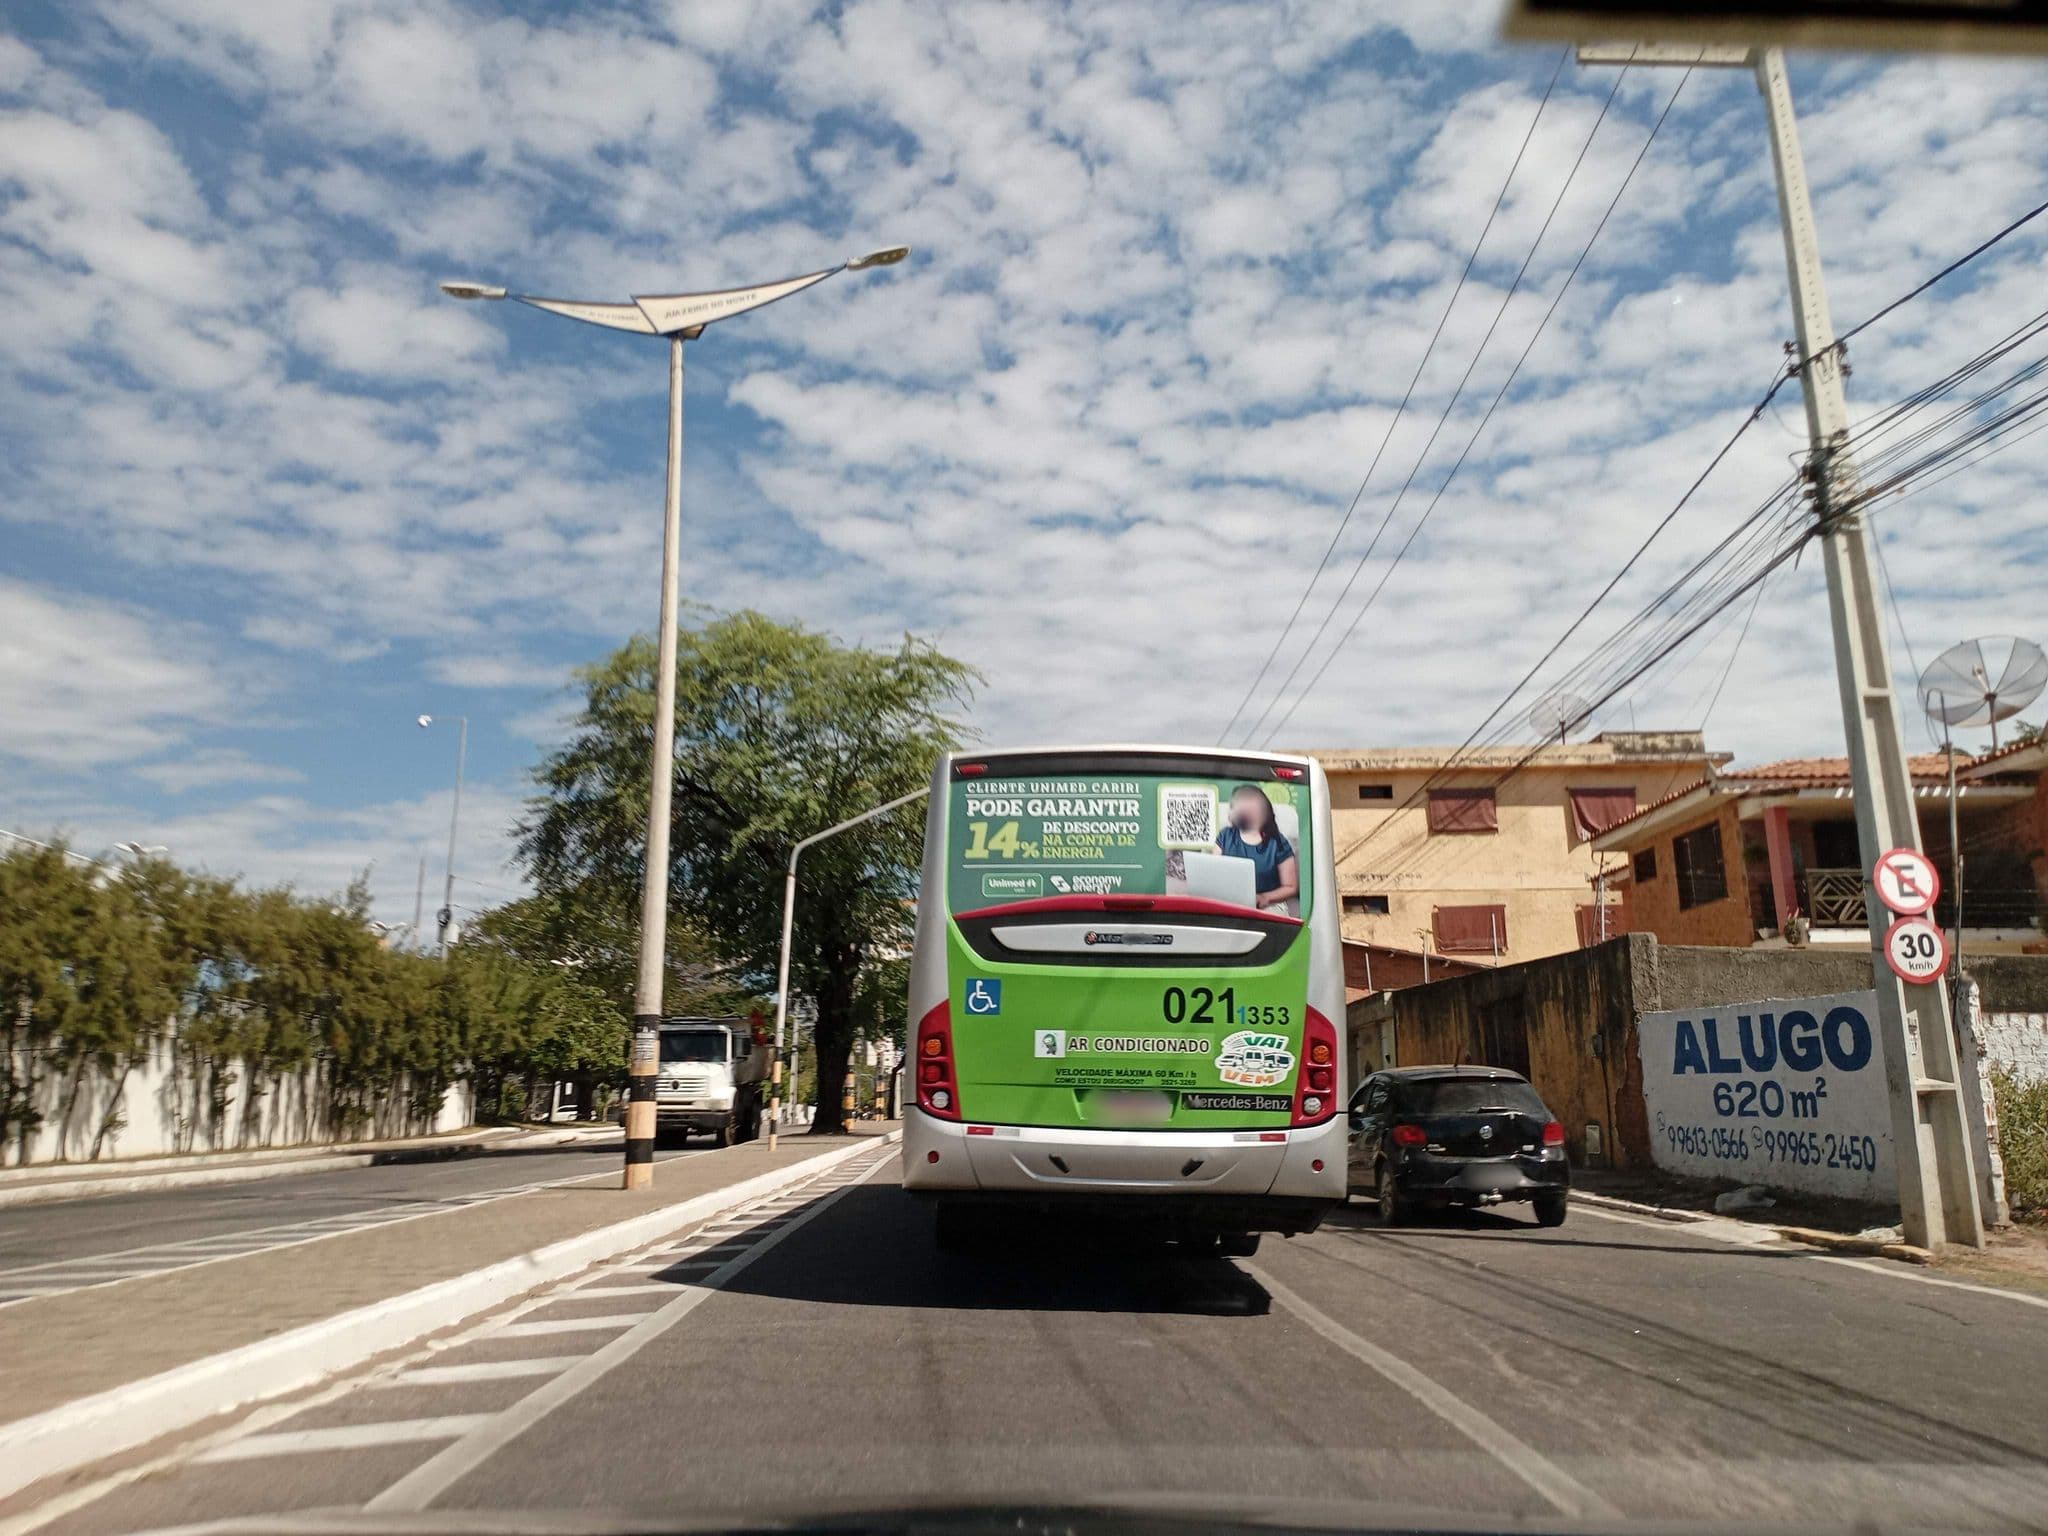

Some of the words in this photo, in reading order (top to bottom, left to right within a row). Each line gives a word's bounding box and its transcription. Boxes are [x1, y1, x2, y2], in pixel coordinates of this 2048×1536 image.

[966, 782, 1026, 794] CLIENTE
[1030, 782, 1088, 794] UNIMED
[1091, 782, 1140, 794] CARIRI
[966, 799, 1023, 817] PODE
[1027, 799, 1141, 817] GARANTIR
[1043, 821, 1063, 834] DE
[1064, 821, 1140, 834] DESCONTO
[1043, 834, 1064, 846] NA
[1066, 834, 1114, 846] CONTA
[1117, 834, 1137, 846] DE
[1042, 847, 1105, 859] ENERGIA
[988, 877, 1026, 888] Unimed
[1072, 875, 1122, 888] economy
[1072, 883, 1111, 895] energy
[1899, 933, 1935, 959] 30
[1908, 961, 1934, 971] km/h
[1163, 986, 1234, 1024] 021
[1237, 1006, 1290, 1025] 1353
[1068, 1038, 1088, 1051] AR
[1094, 1038, 1210, 1053] CONDICIONADO
[1672, 1006, 1873, 1075] ALUGO
[1055, 1068, 1113, 1077] VELOCIDADE
[1115, 1067, 1153, 1078] MÁXIMA
[1155, 1069, 1166, 1078] 60
[1224, 1069, 1275, 1084] VEM
[1186, 1094, 1289, 1110] Mercedes-Benz
[1713, 1080, 1785, 1118] 620
